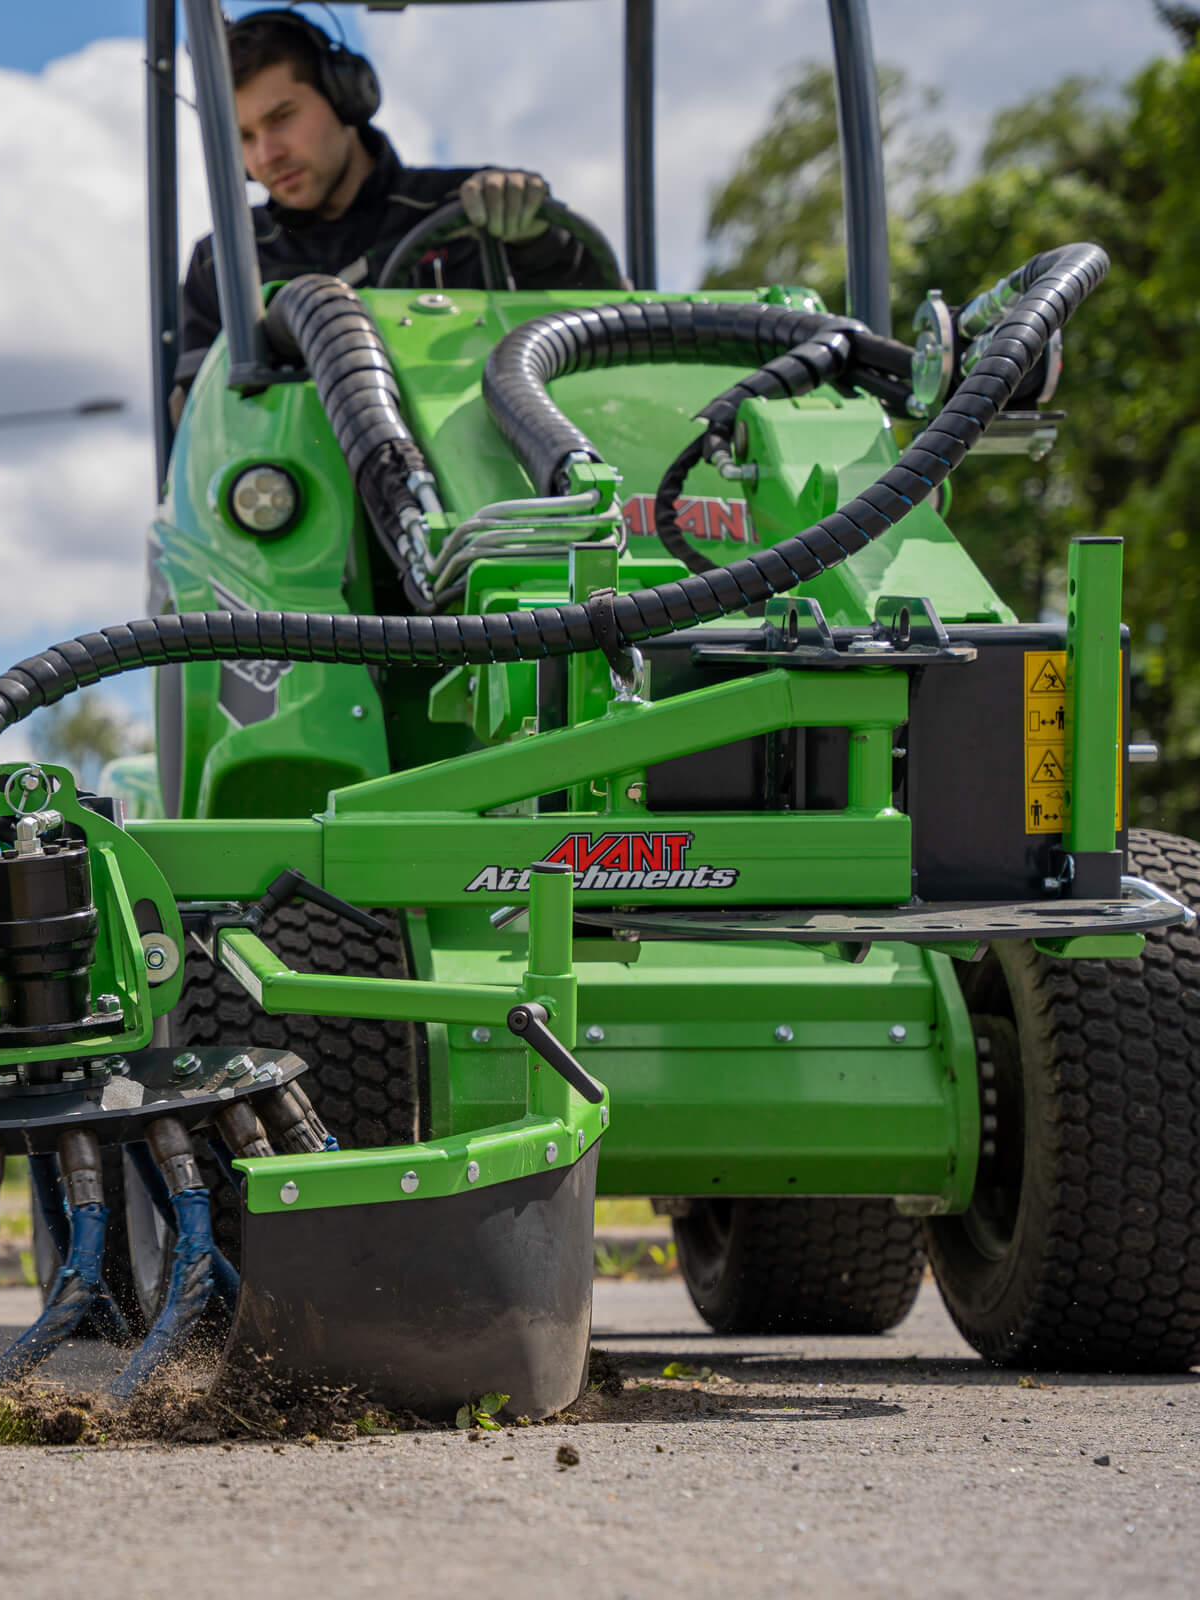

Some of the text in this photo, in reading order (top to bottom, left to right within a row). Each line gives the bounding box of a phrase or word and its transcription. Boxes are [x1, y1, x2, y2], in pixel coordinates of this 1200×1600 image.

[622, 494, 759, 543] AVAN
[541, 829, 691, 871] AVANT
[464, 865, 738, 892] Attchments
